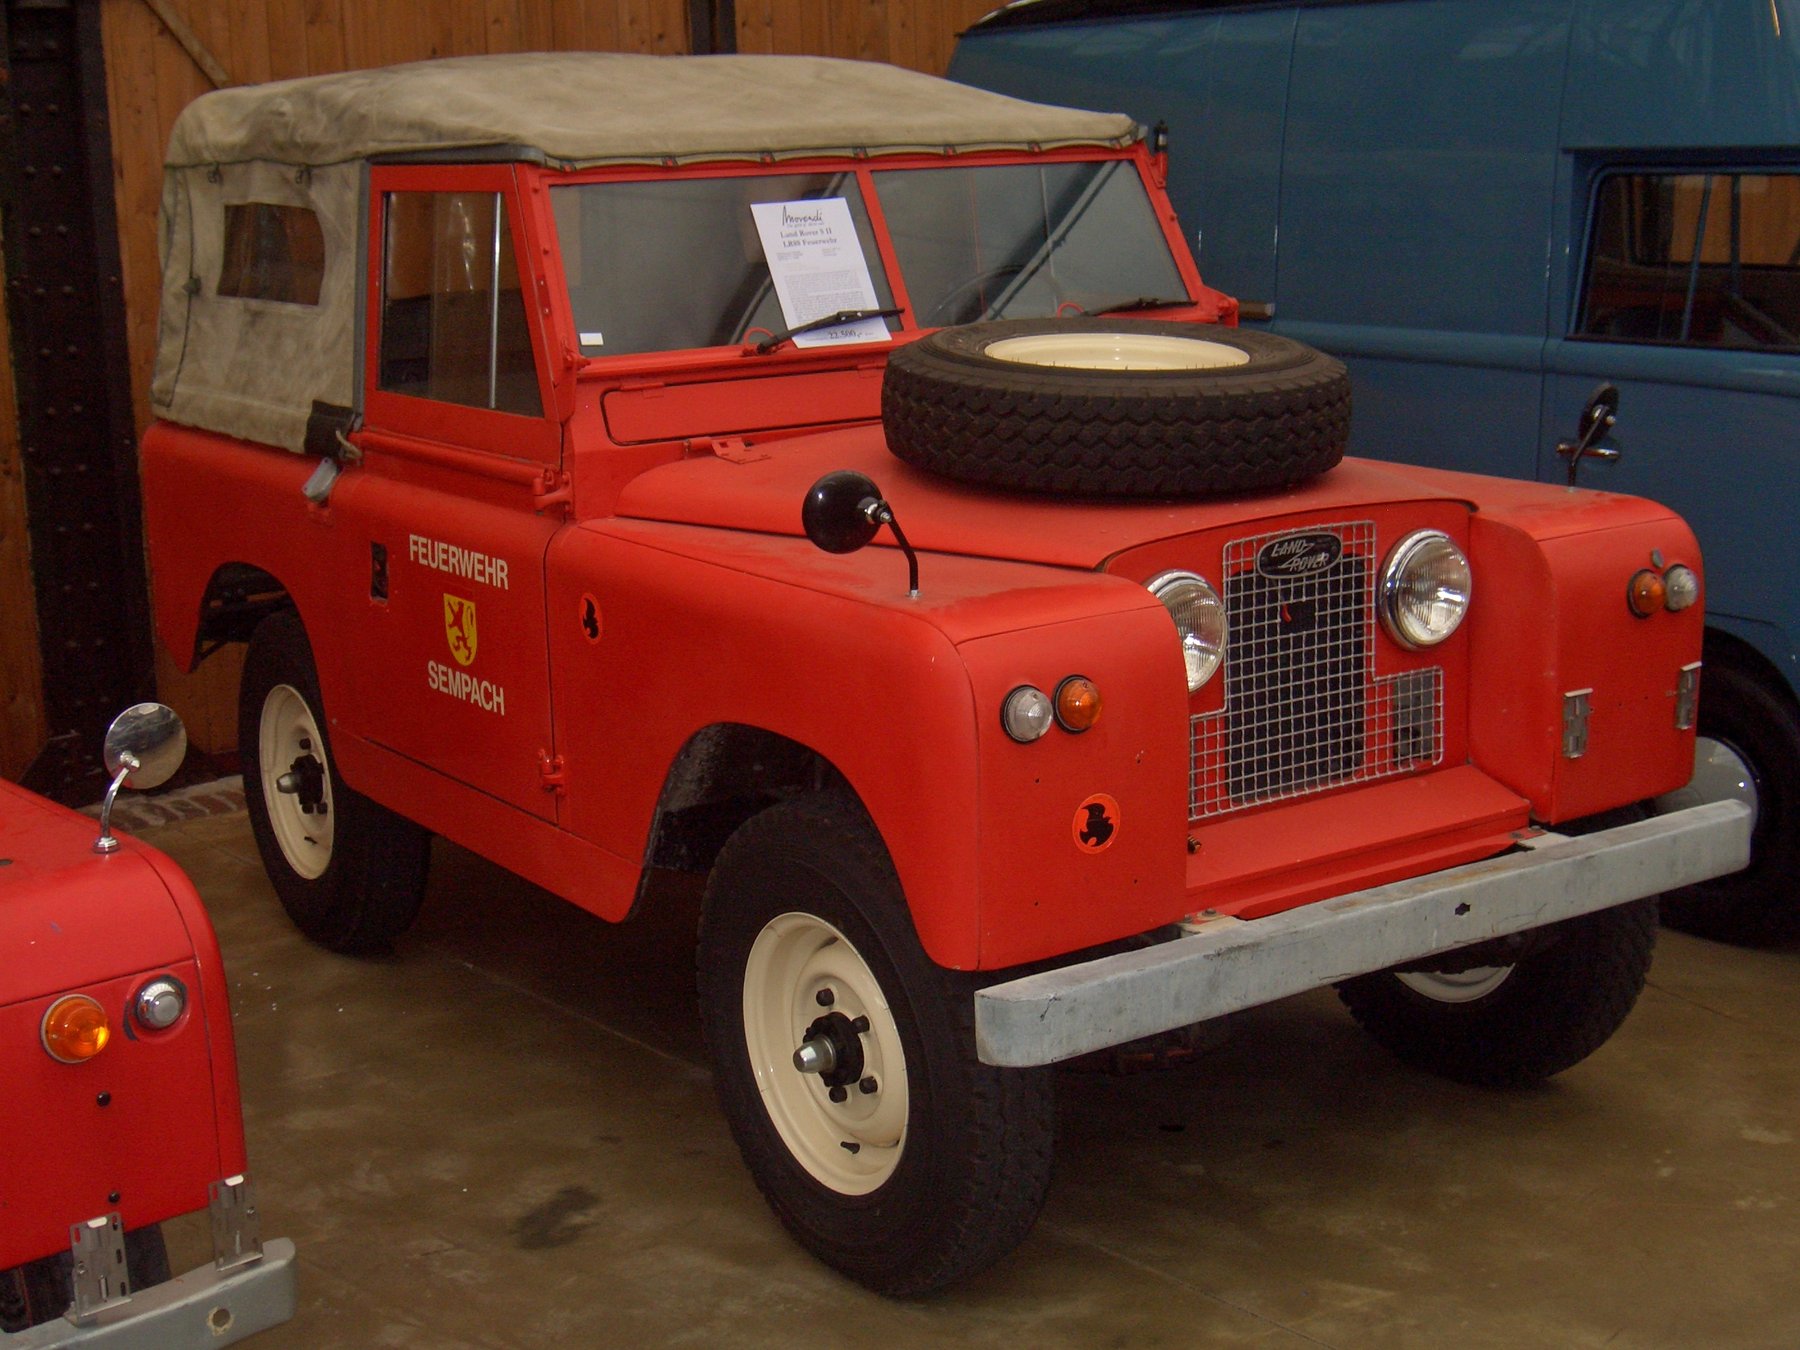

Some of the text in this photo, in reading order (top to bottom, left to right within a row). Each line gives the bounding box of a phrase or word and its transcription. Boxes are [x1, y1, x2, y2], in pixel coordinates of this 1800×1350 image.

[780, 230, 798, 239] Land
[799, 228, 819, 237] Rover
[802, 238, 838, 247] Feuerwehr
[1271, 539, 1307, 557] LAND
[409, 534, 509, 590] FEUERWEHR
[1289, 552, 1330, 572] ROVER
[427, 660, 505, 716] SEMPACH
